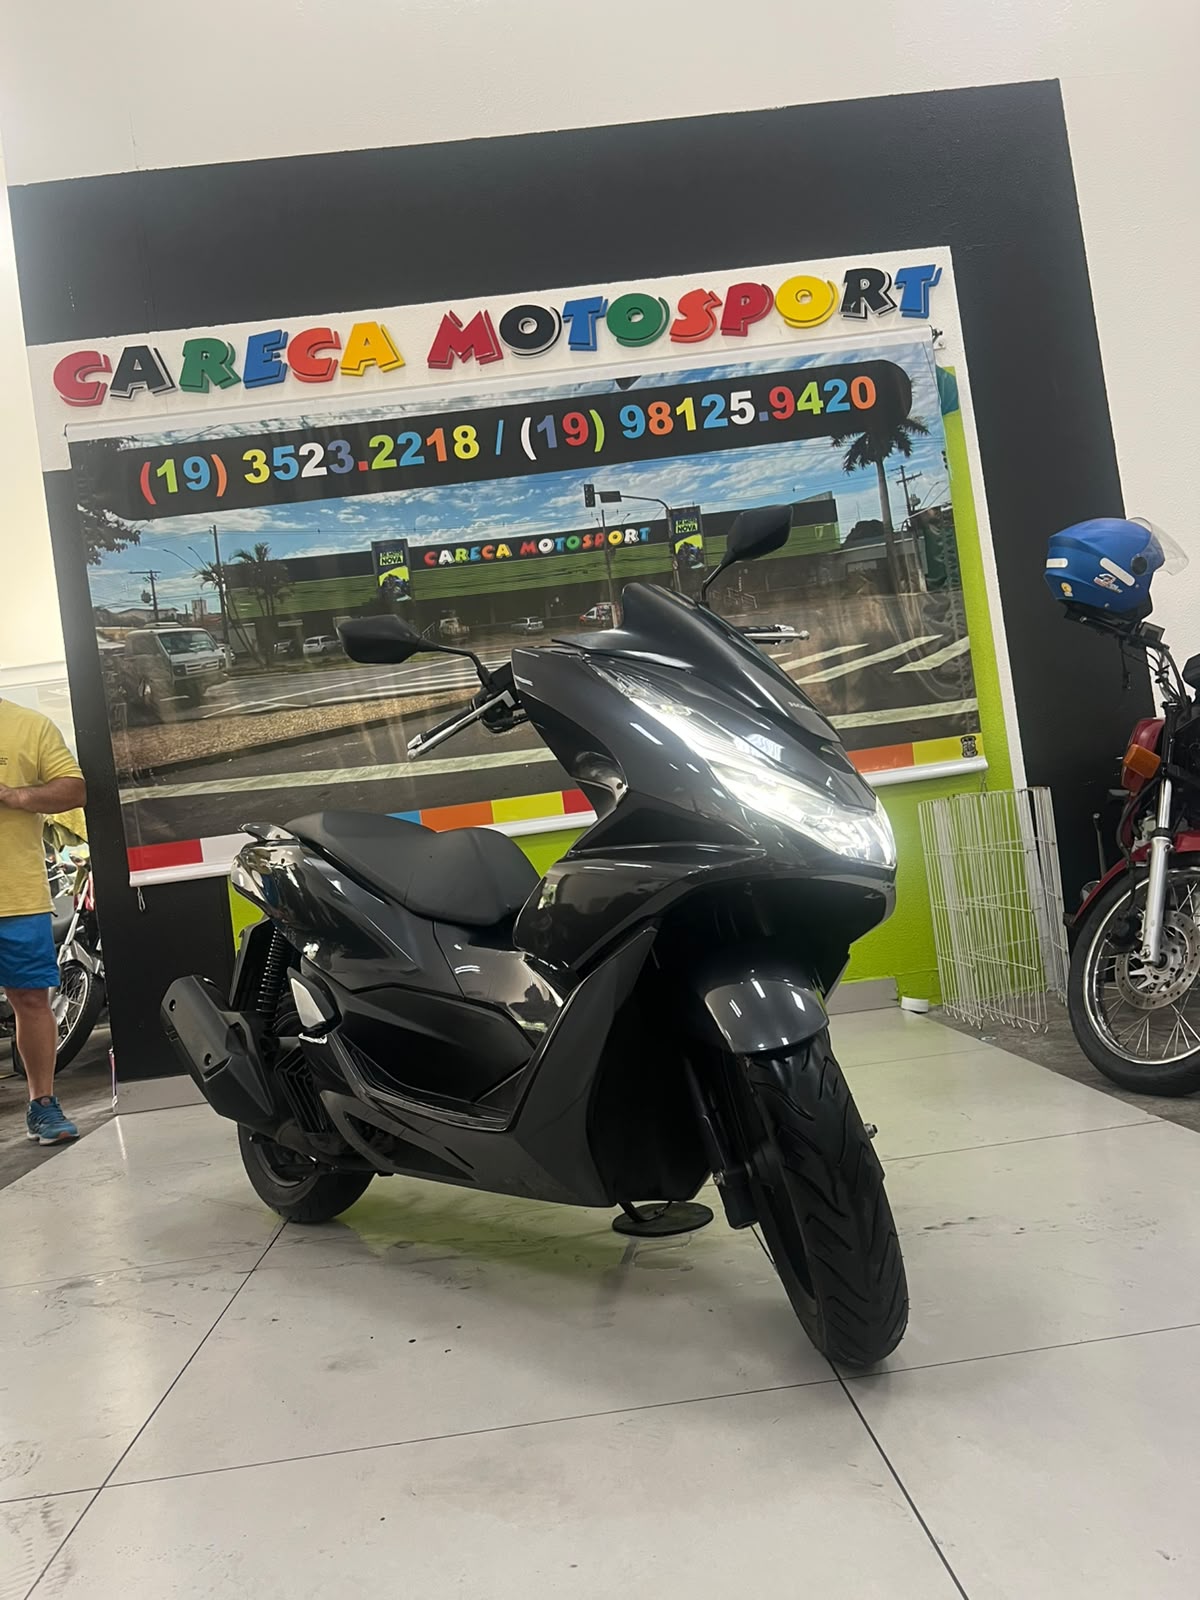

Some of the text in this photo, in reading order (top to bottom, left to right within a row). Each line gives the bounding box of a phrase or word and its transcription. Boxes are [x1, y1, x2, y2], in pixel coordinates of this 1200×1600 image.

[53, 264, 942, 407] CARECA MOTOSPORT
[140, 376, 877, 505] (19) 3523.2218 / (19) 98125.9420
[423, 527, 650, 567] CARECA MOTOSPORT
[677, 524, 697, 533] NOVA
[381, 556, 402, 565] NOVA
